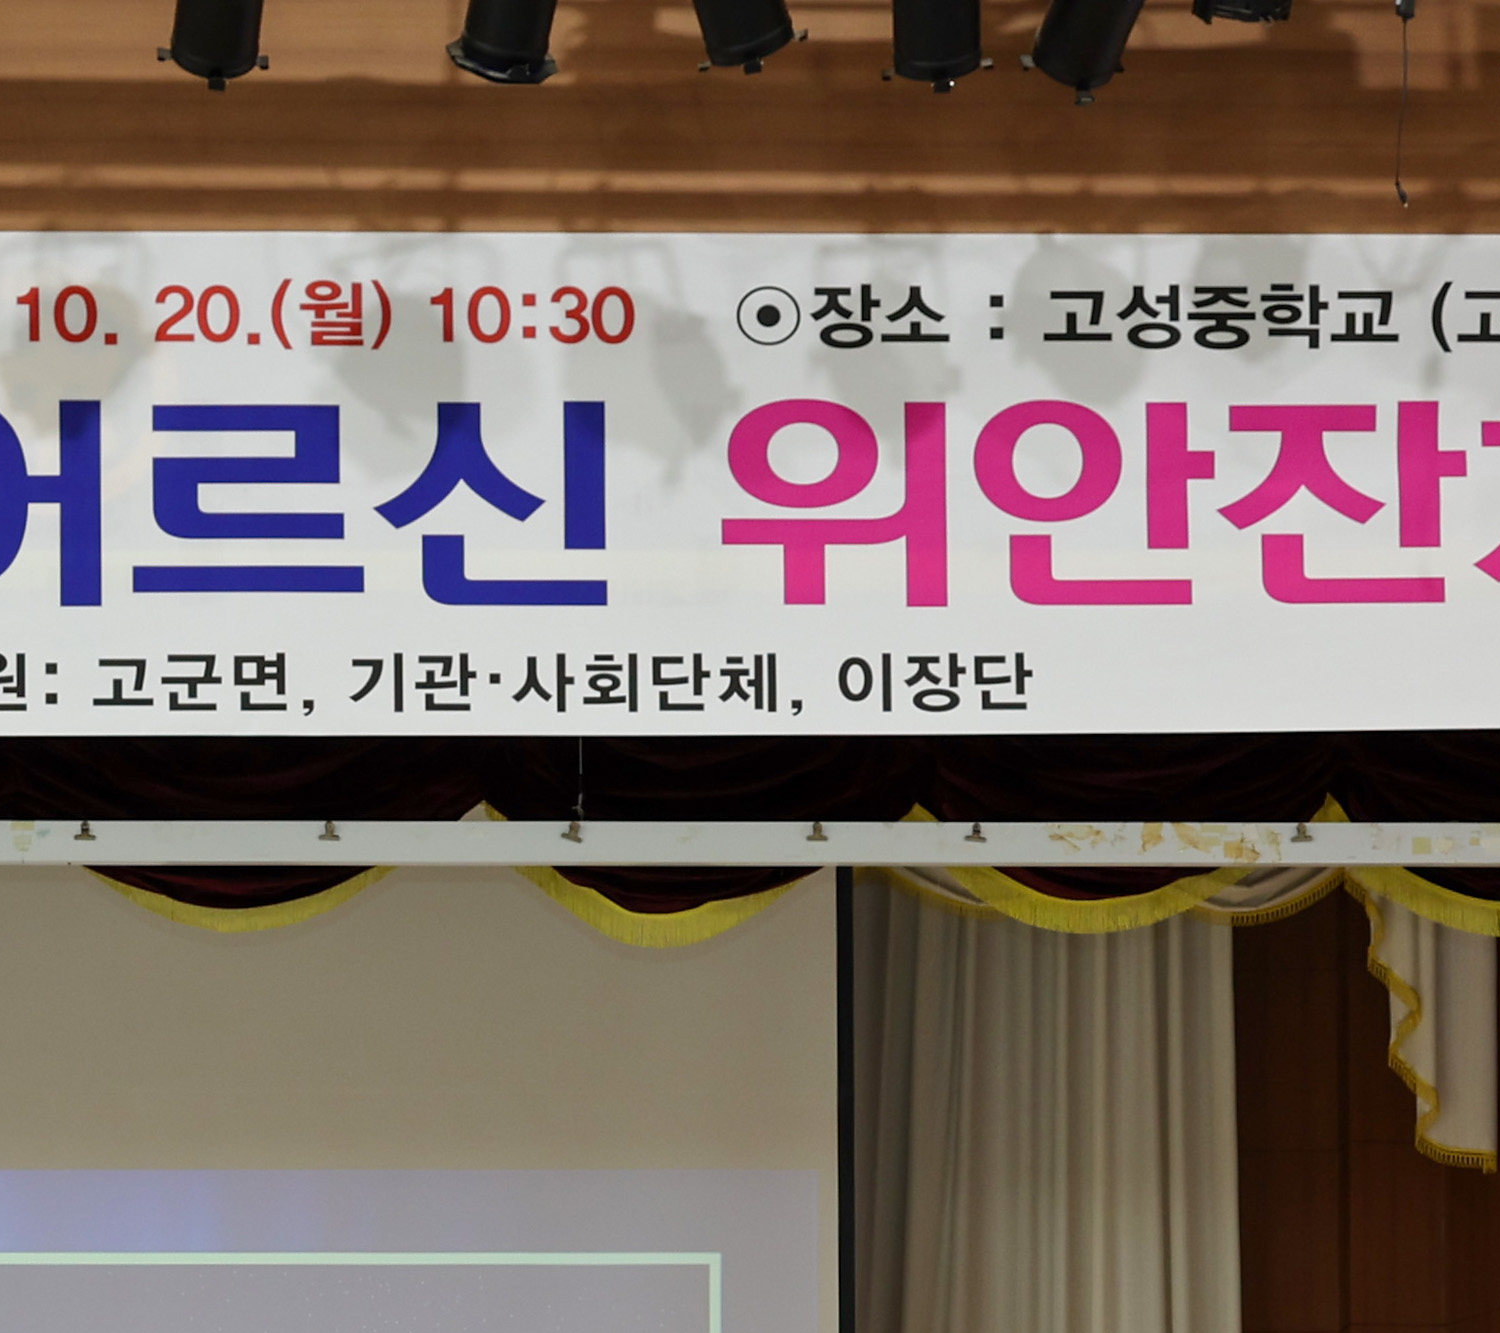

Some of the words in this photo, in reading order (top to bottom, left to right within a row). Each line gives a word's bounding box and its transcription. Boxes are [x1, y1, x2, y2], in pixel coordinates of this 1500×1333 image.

[18, 286, 117, 345] 10.
[155, 280, 391, 349] 20.(월)
[431, 287, 634, 344] 10:30
[811, 285, 949, 348] 장소
[1044, 284, 1398, 349] 고성중학교
[93, 653, 314, 716] 고군면,
[839, 653, 1032, 712] 이장단
